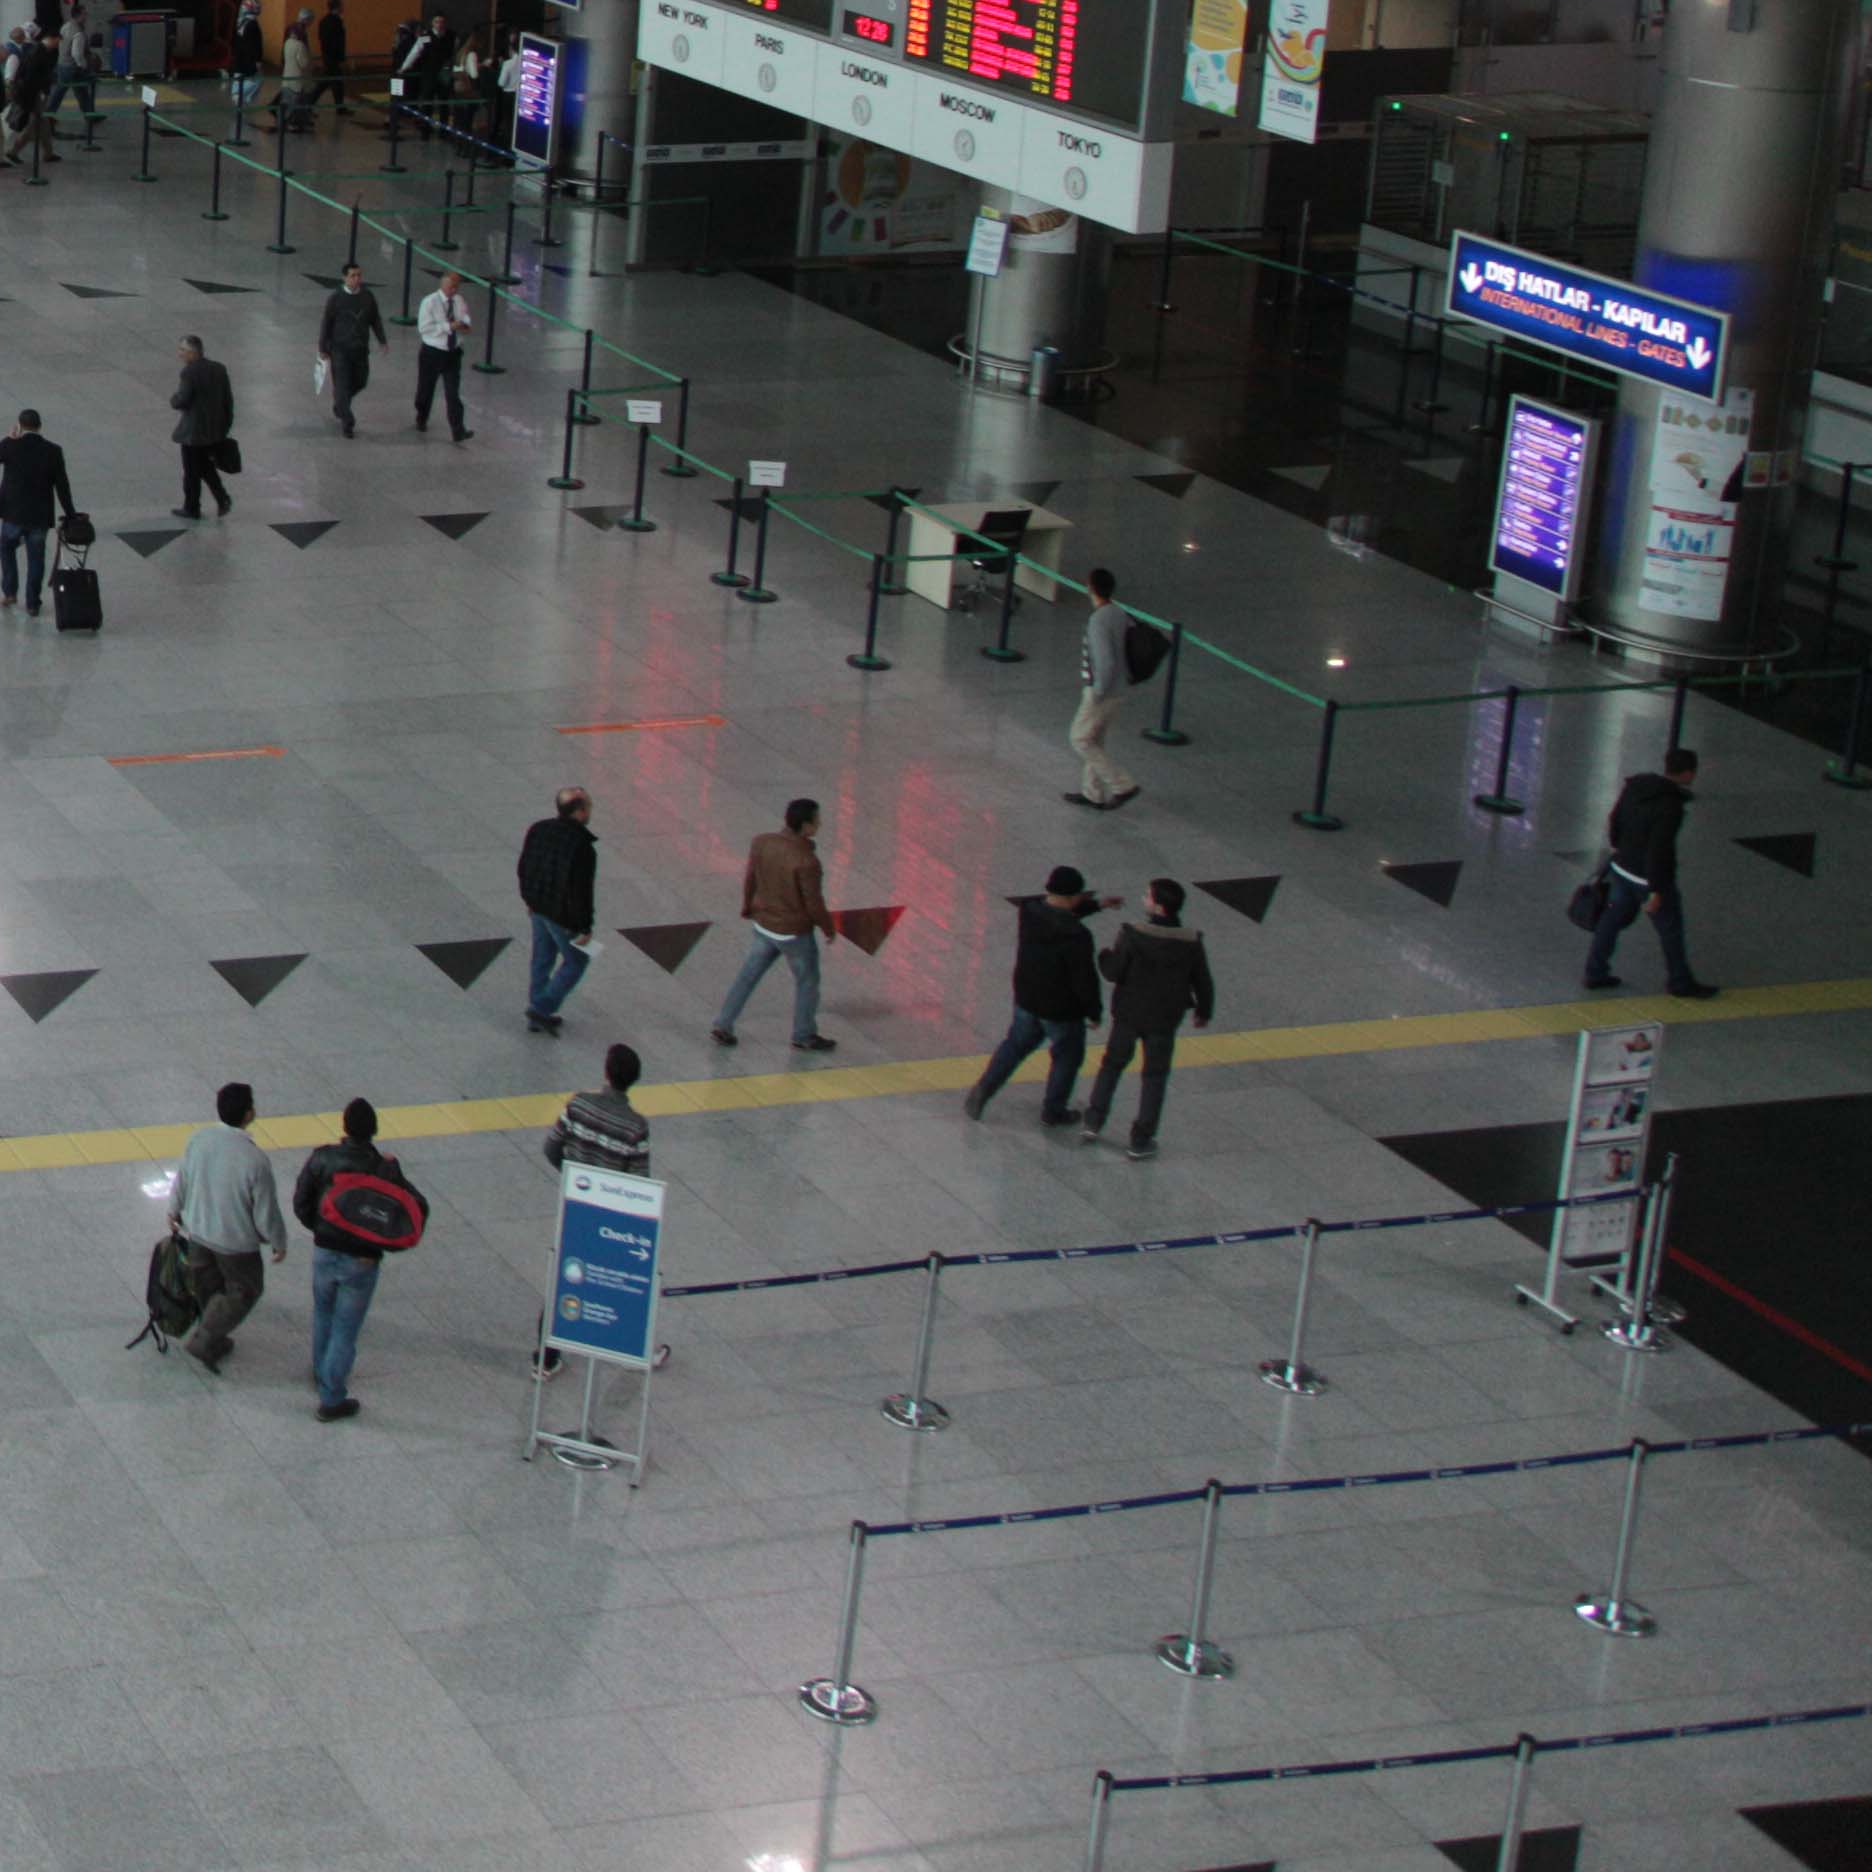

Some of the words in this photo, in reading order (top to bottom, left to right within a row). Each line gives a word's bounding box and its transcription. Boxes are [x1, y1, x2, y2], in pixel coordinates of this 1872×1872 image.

[658, 2, 681, 21] NEW
[682, 9, 709, 31] YORK
[754, 33, 785, 55] PARIS
[841, 61, 888, 89] LONDON
[939, 92, 996, 124] MOSCOW
[1058, 130, 1102, 158] TOKYO
[1484, 260, 1517, 293] DIŞ
[1518, 272, 1591, 312] HATLAR
[1603, 302, 1686, 343] KAPILAR
[1480, 285, 1584, 334] INTERNATIONAL
[1586, 321, 1626, 349] LINES
[1638, 339, 1686, 368] GATES
[598, 1226, 653, 1248] Check-in
